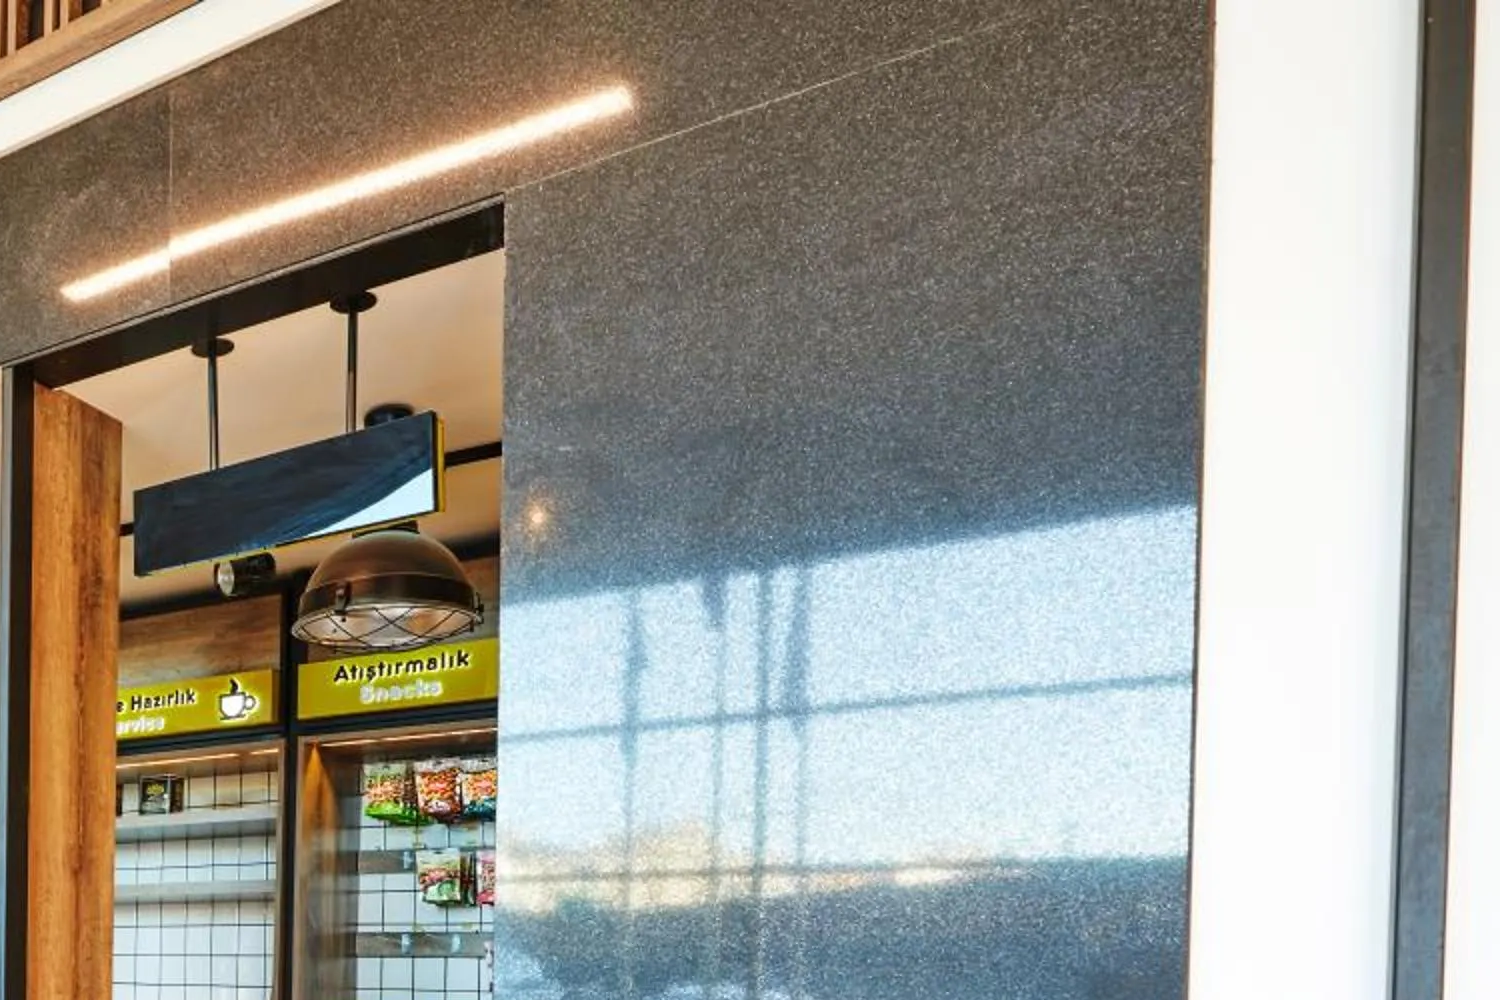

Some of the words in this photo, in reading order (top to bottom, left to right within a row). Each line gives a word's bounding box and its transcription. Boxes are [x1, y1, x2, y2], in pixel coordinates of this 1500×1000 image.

[333, 649, 470, 684] Atıştırmalık
[130, 686, 197, 712] Hazırlık
[359, 679, 443, 705] Snacks
